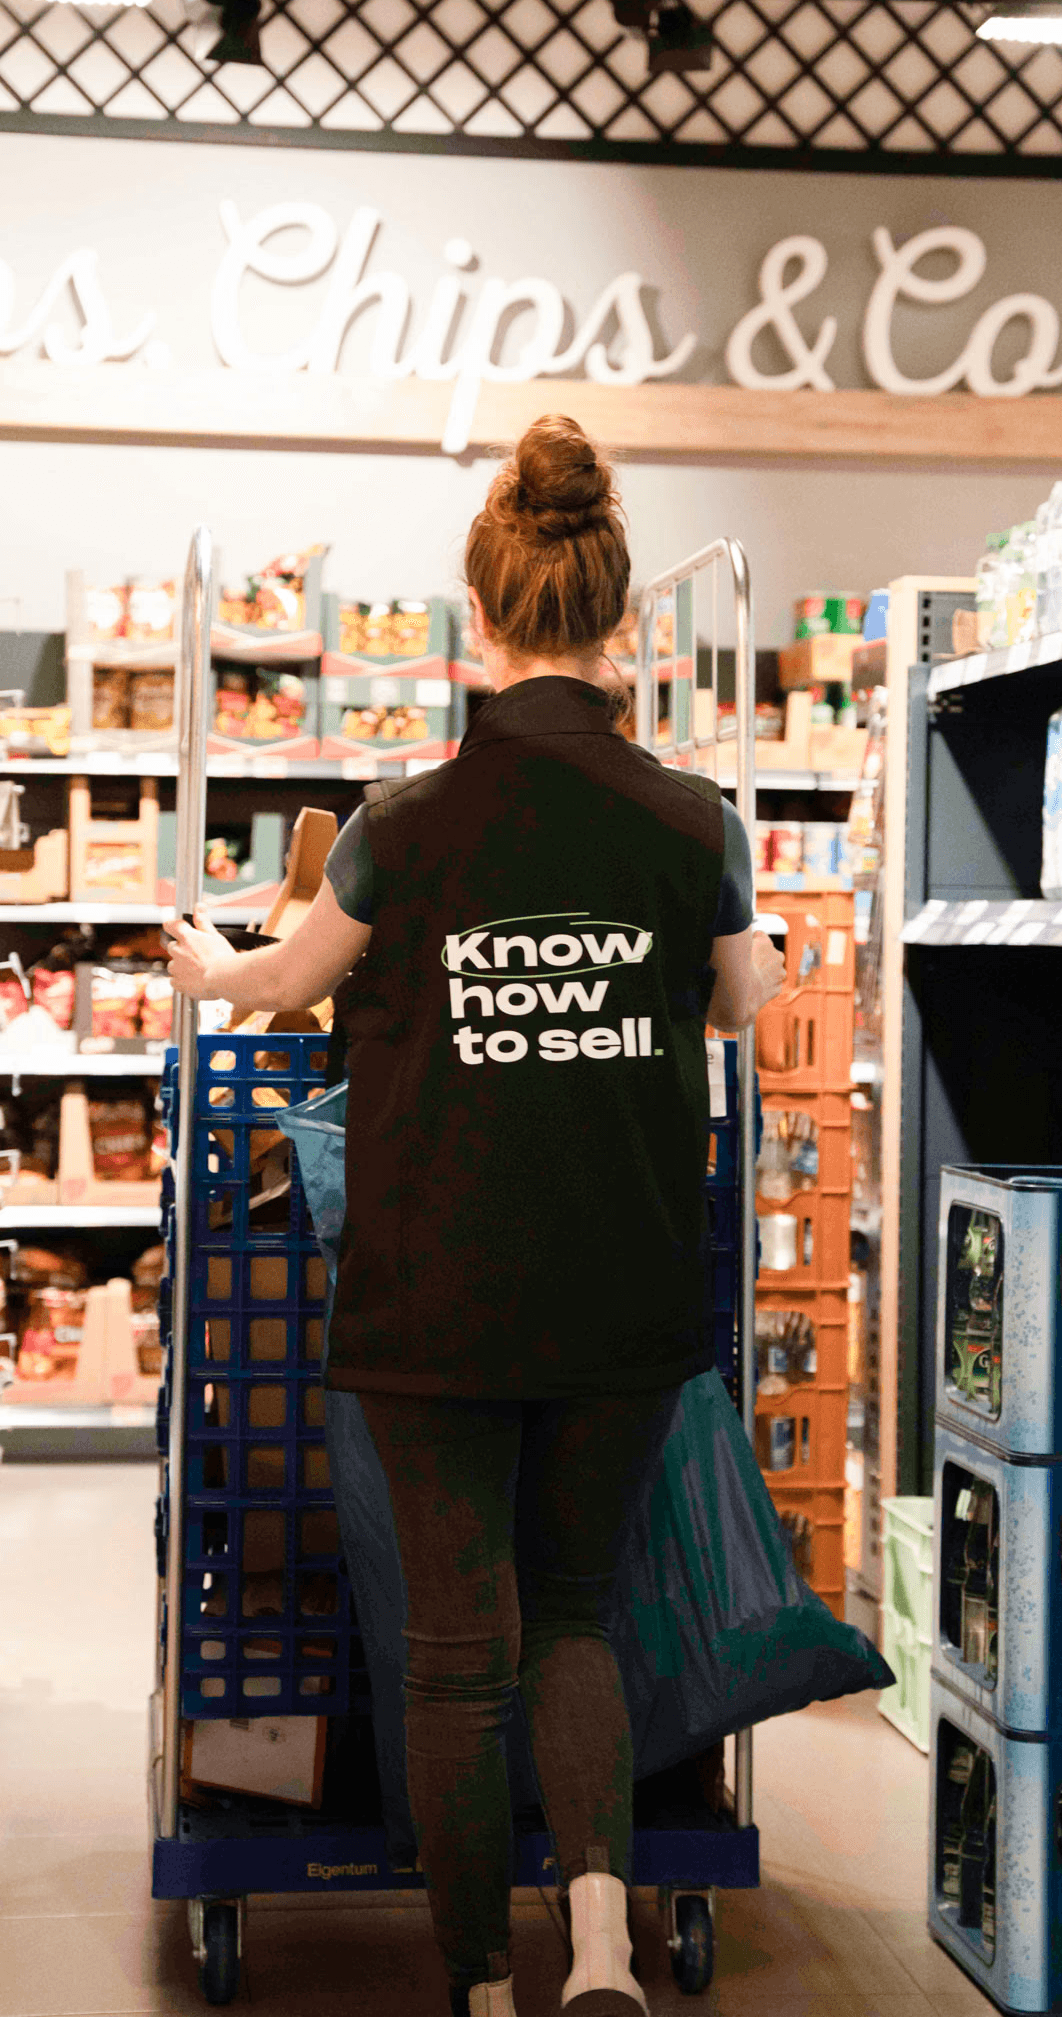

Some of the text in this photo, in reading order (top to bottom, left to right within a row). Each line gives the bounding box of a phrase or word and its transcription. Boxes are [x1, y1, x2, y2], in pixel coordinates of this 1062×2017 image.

[210, 199, 697, 455] Chips
[727, 235, 837, 392] &
[446, 932, 654, 971] Know
[449, 978, 609, 1018] how
[453, 1017, 664, 1065] to sell.
[307, 1862, 378, 1880] Eigentum
